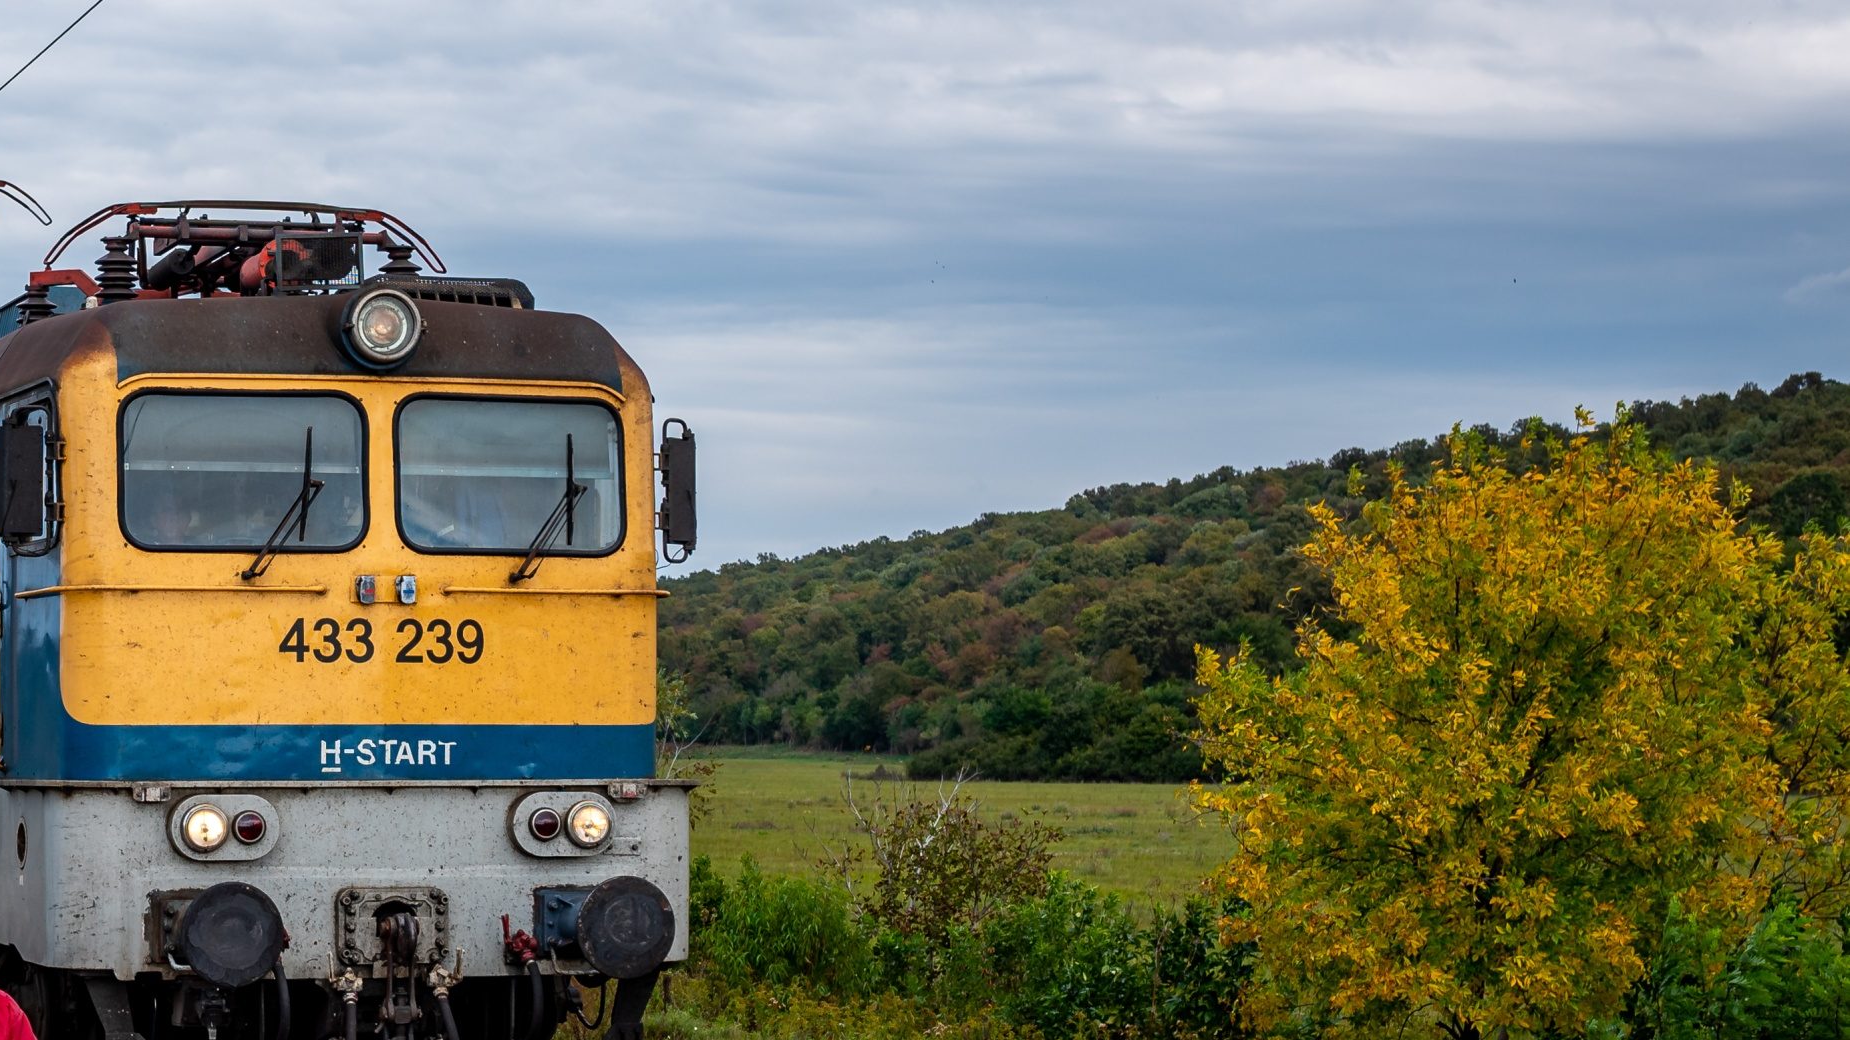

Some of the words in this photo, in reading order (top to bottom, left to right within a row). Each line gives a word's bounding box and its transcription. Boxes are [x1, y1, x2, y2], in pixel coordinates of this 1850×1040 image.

[278, 617, 375, 664] 433
[395, 618, 485, 665] 239
[319, 738, 458, 767] H-START
